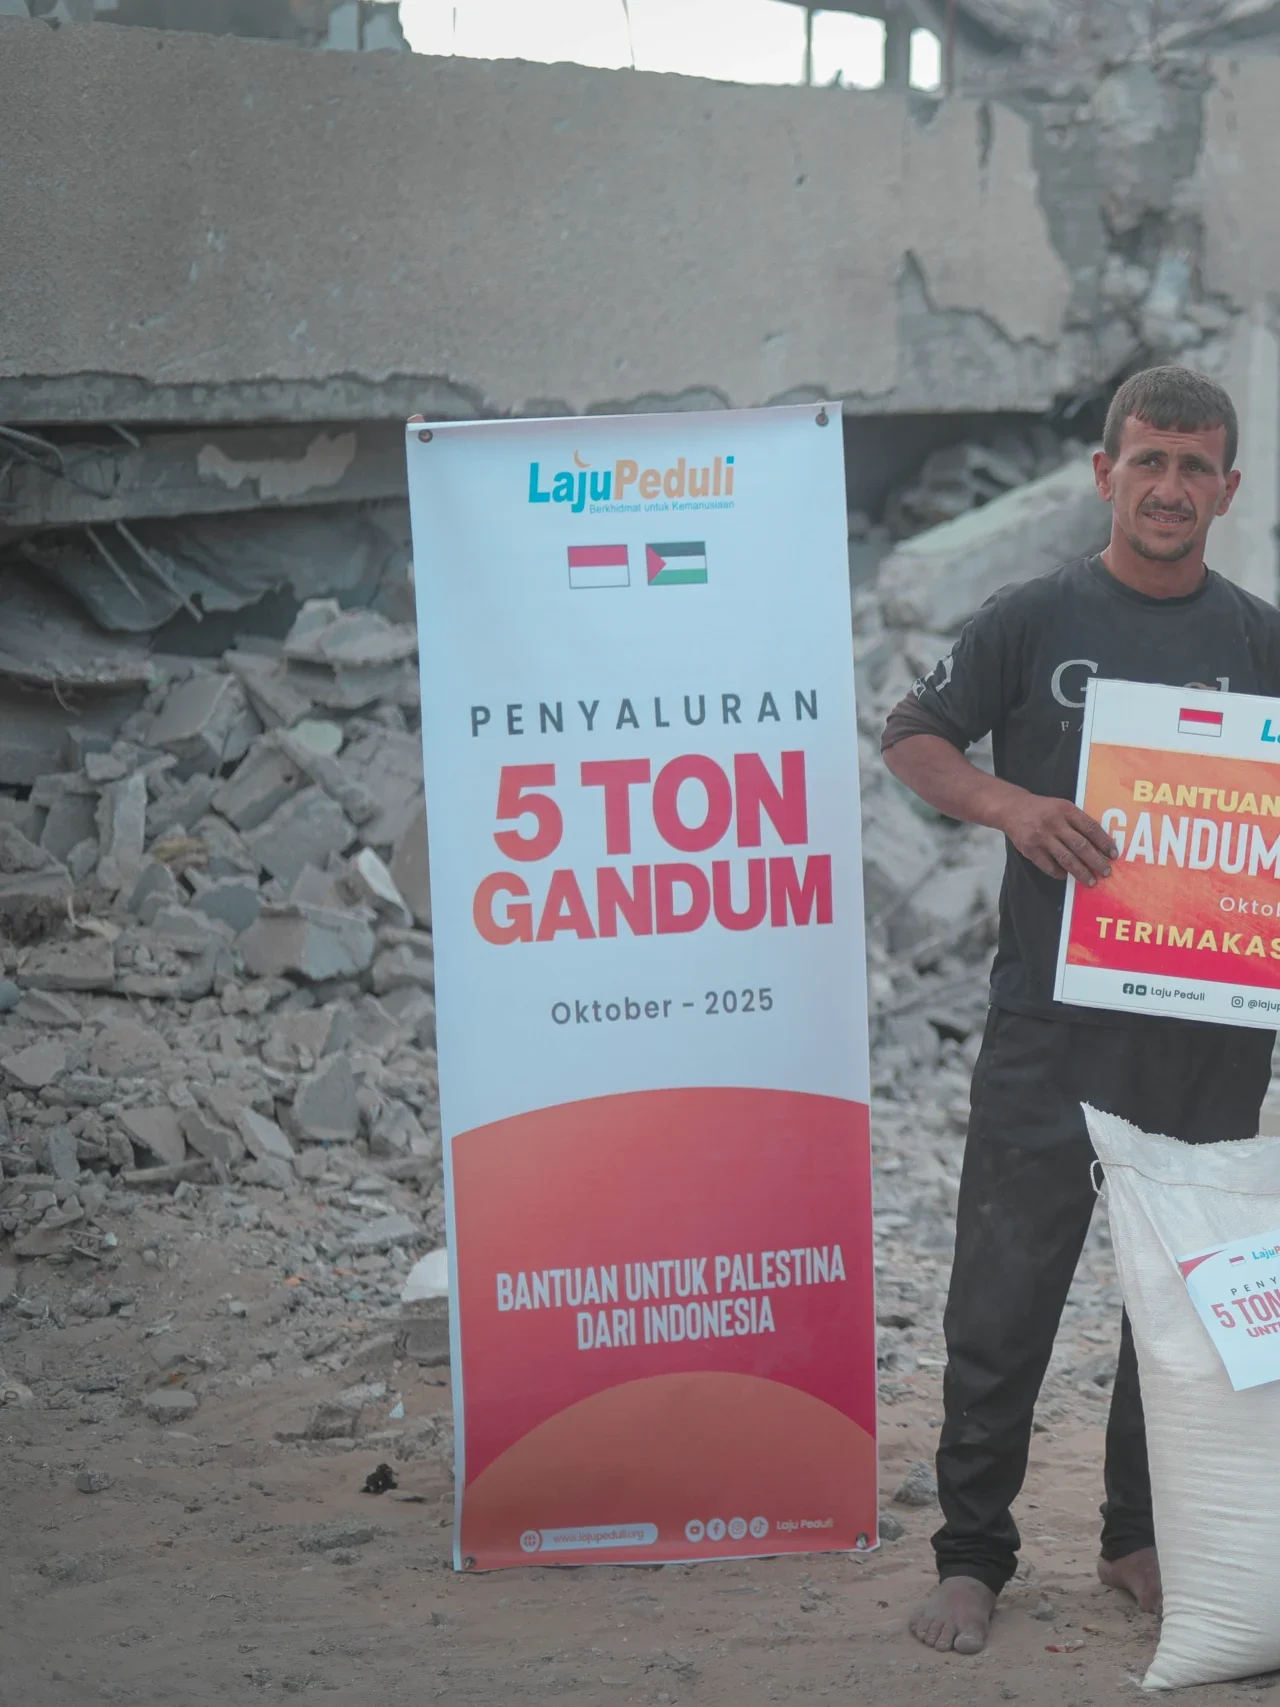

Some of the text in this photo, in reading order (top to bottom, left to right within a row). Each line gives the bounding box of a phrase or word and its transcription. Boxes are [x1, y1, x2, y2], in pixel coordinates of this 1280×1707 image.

[529, 453, 735, 513] LajuPeduli
[589, 500, 735, 514] Berkhidmat untuk Kemanusiaan
[471, 689, 818, 737] PENYALURAN
[493, 750, 808, 863] 5 TON
[472, 854, 833, 946] GANDUM
[551, 996, 672, 1025] Oktober
[704, 988, 774, 1015] 2025
[1150, 986, 1205, 1001] Laju Peduli
[496, 1244, 846, 1311] BANTUAN UNTUK PALESTINA
[577, 1296, 775, 1350] DARI INDONESIA
[1211, 1303, 1236, 1329] 5
